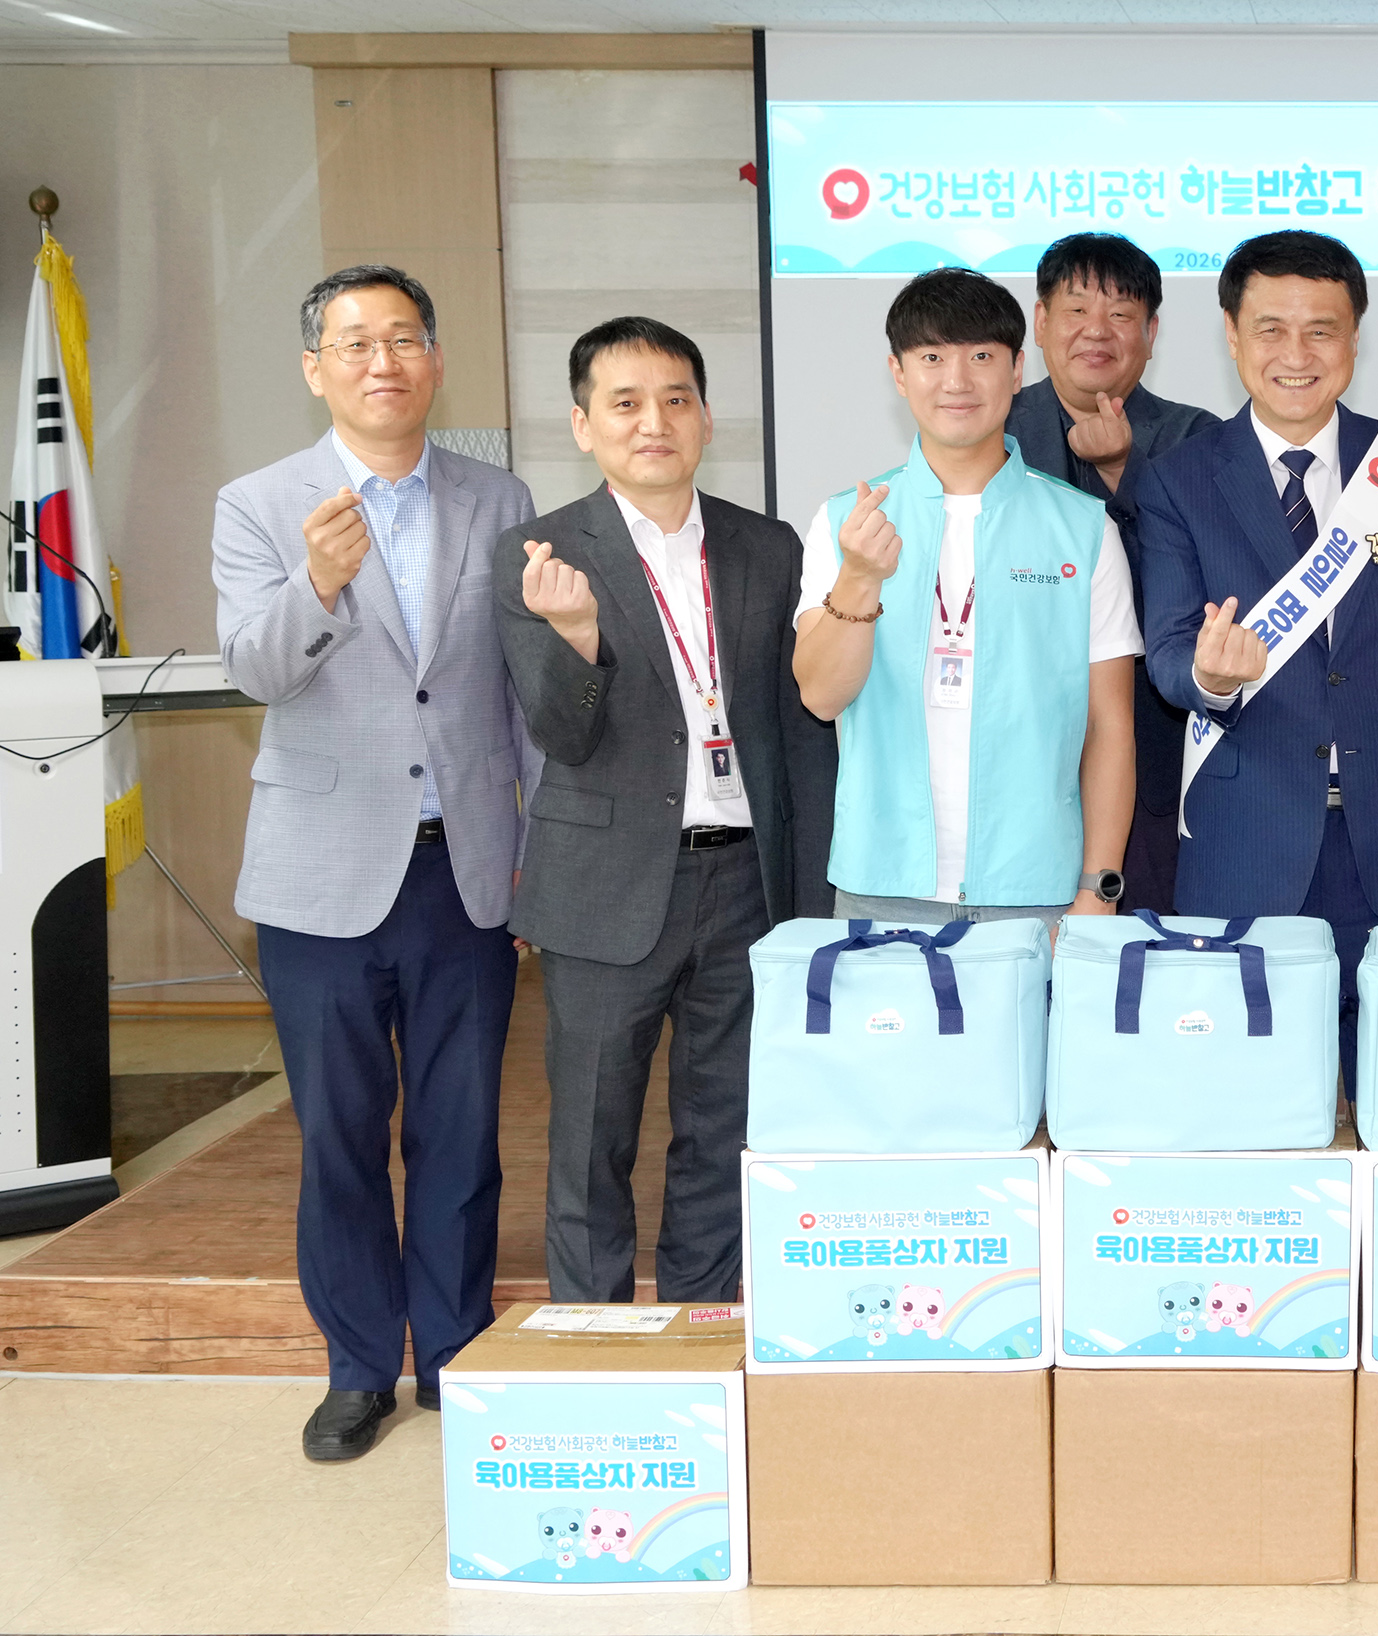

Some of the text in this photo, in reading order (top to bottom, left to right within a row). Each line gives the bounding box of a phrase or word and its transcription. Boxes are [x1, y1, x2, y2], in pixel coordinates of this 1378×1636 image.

[880, 170, 1015, 219] 건강보험
[1023, 169, 1165, 218] 사회공헌
[1180, 164, 1362, 216] 하늘반창고
[1175, 252, 1222, 268] 2026
[1300, 527, 1358, 598] 일일
[1010, 573, 1060, 584] 국민건강보험
[818, 1209, 990, 1229] 건강보험 사회공헌 하늘반창고
[1132, 1208, 1301, 1226] 건강보험 사회공헌 하늘반창고
[784, 1237, 1008, 1267] 육아용품상자 지원
[1096, 1235, 1319, 1264] 육아용품상자 지원
[509, 1433, 677, 1451] 건강보험 사회공헌 하늘반창고
[475, 1461, 696, 1489] 육아용품상자 지원
